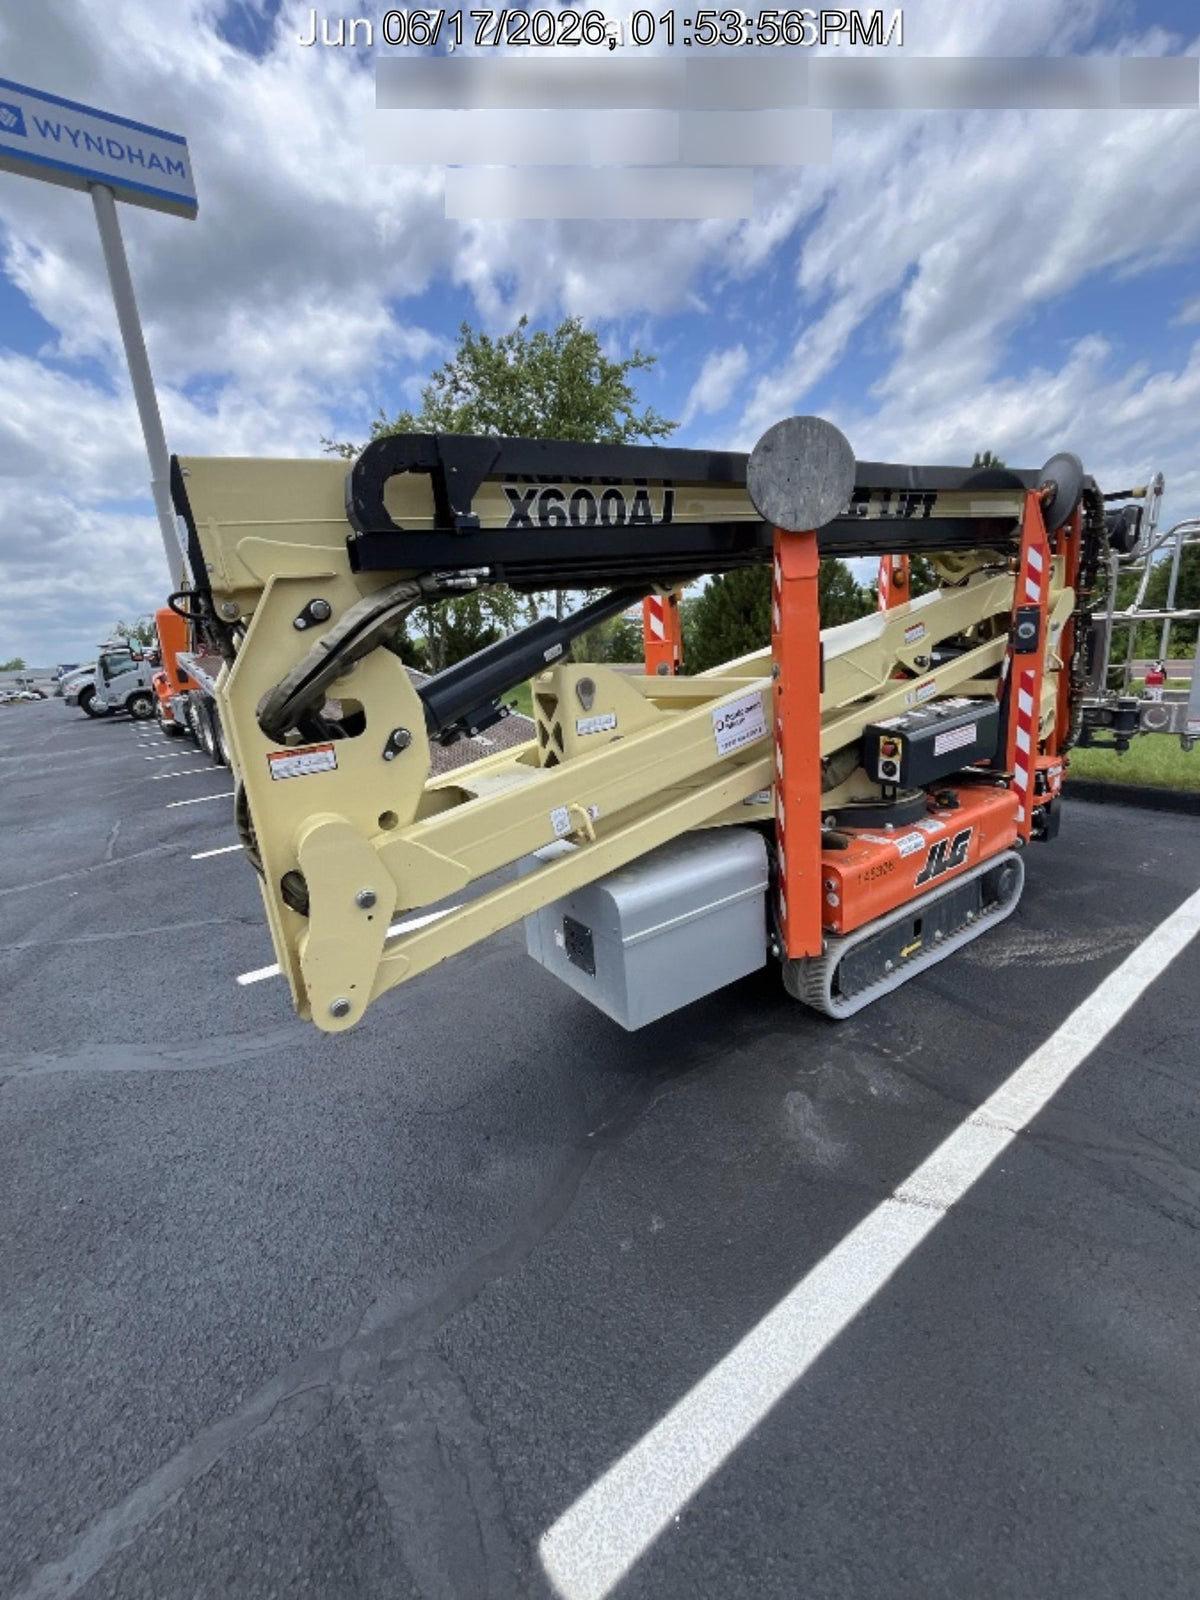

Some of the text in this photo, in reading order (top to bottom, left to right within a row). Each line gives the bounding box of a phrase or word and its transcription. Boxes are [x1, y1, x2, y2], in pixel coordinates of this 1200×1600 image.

[32, 115, 187, 179] WYNDHAM
[502, 485, 676, 528] X600AJ
[914, 826, 974, 889] JLG
